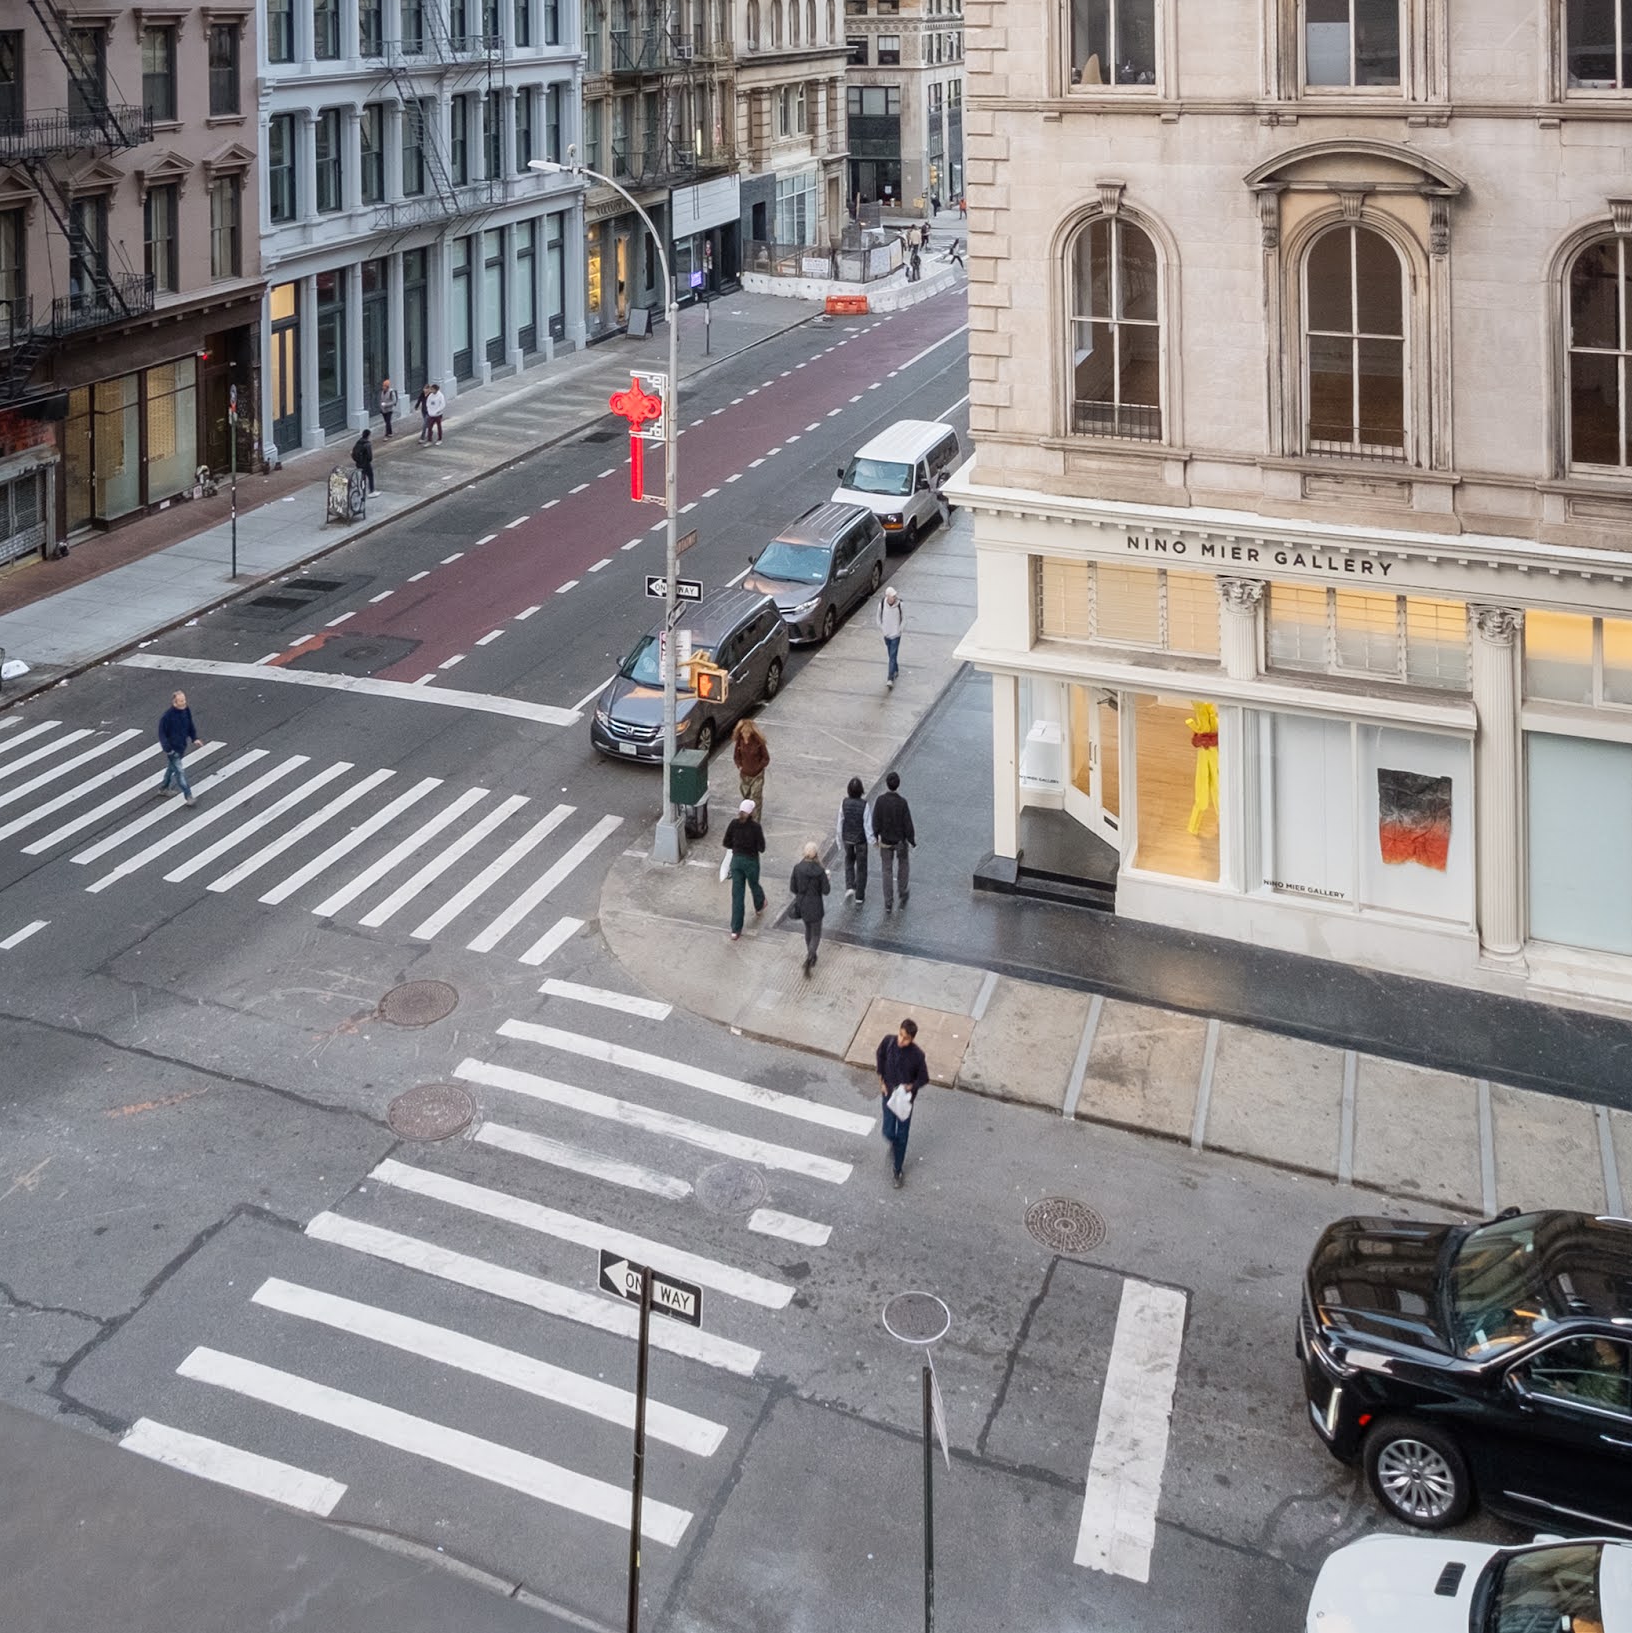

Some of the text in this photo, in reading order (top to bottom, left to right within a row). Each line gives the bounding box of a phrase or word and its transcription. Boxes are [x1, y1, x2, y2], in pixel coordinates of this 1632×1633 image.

[1127, 536, 1392, 576] NINO MIER GALLERY
[677, 586, 695, 594] WAY
[1263, 879, 1345, 898] NINO MIER GALLERY
[625, 1272, 690, 1311] ON WAY
